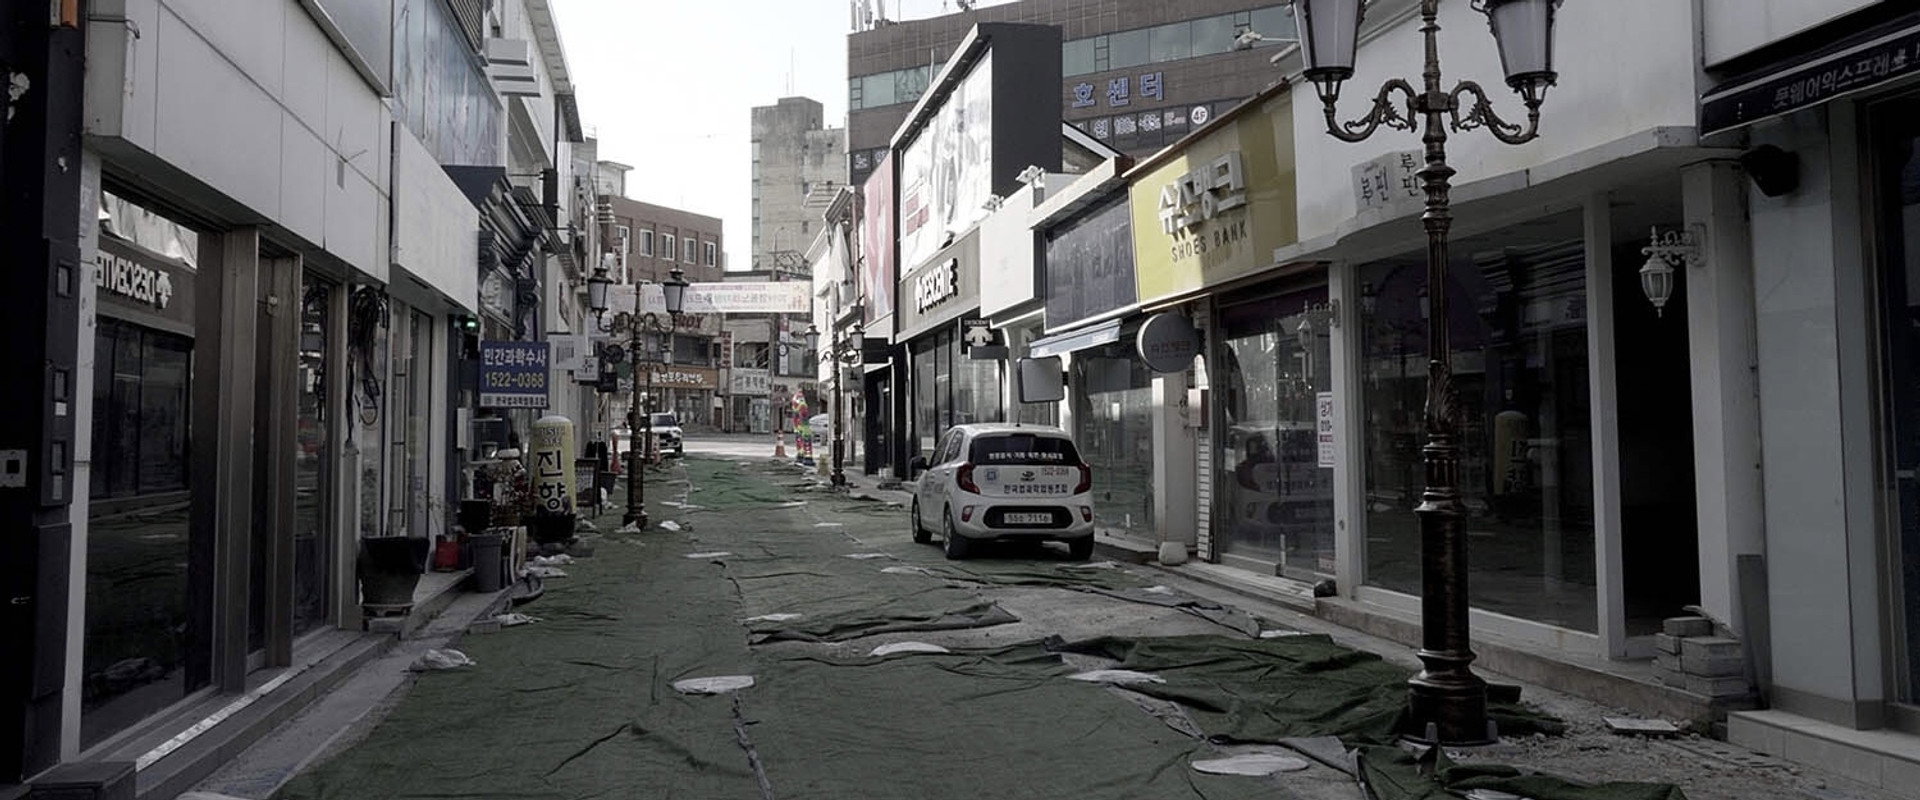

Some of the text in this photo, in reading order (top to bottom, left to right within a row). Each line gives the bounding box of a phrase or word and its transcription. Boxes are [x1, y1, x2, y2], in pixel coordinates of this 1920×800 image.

[1157, 151, 1247, 236] 슈즈뱅크
[1170, 220, 1248, 263] SHOES BANK
[483, 348, 546, 367] 민간과학수사
[484, 371, 544, 388] 1522-0368
[536, 450, 566, 510] 진향
